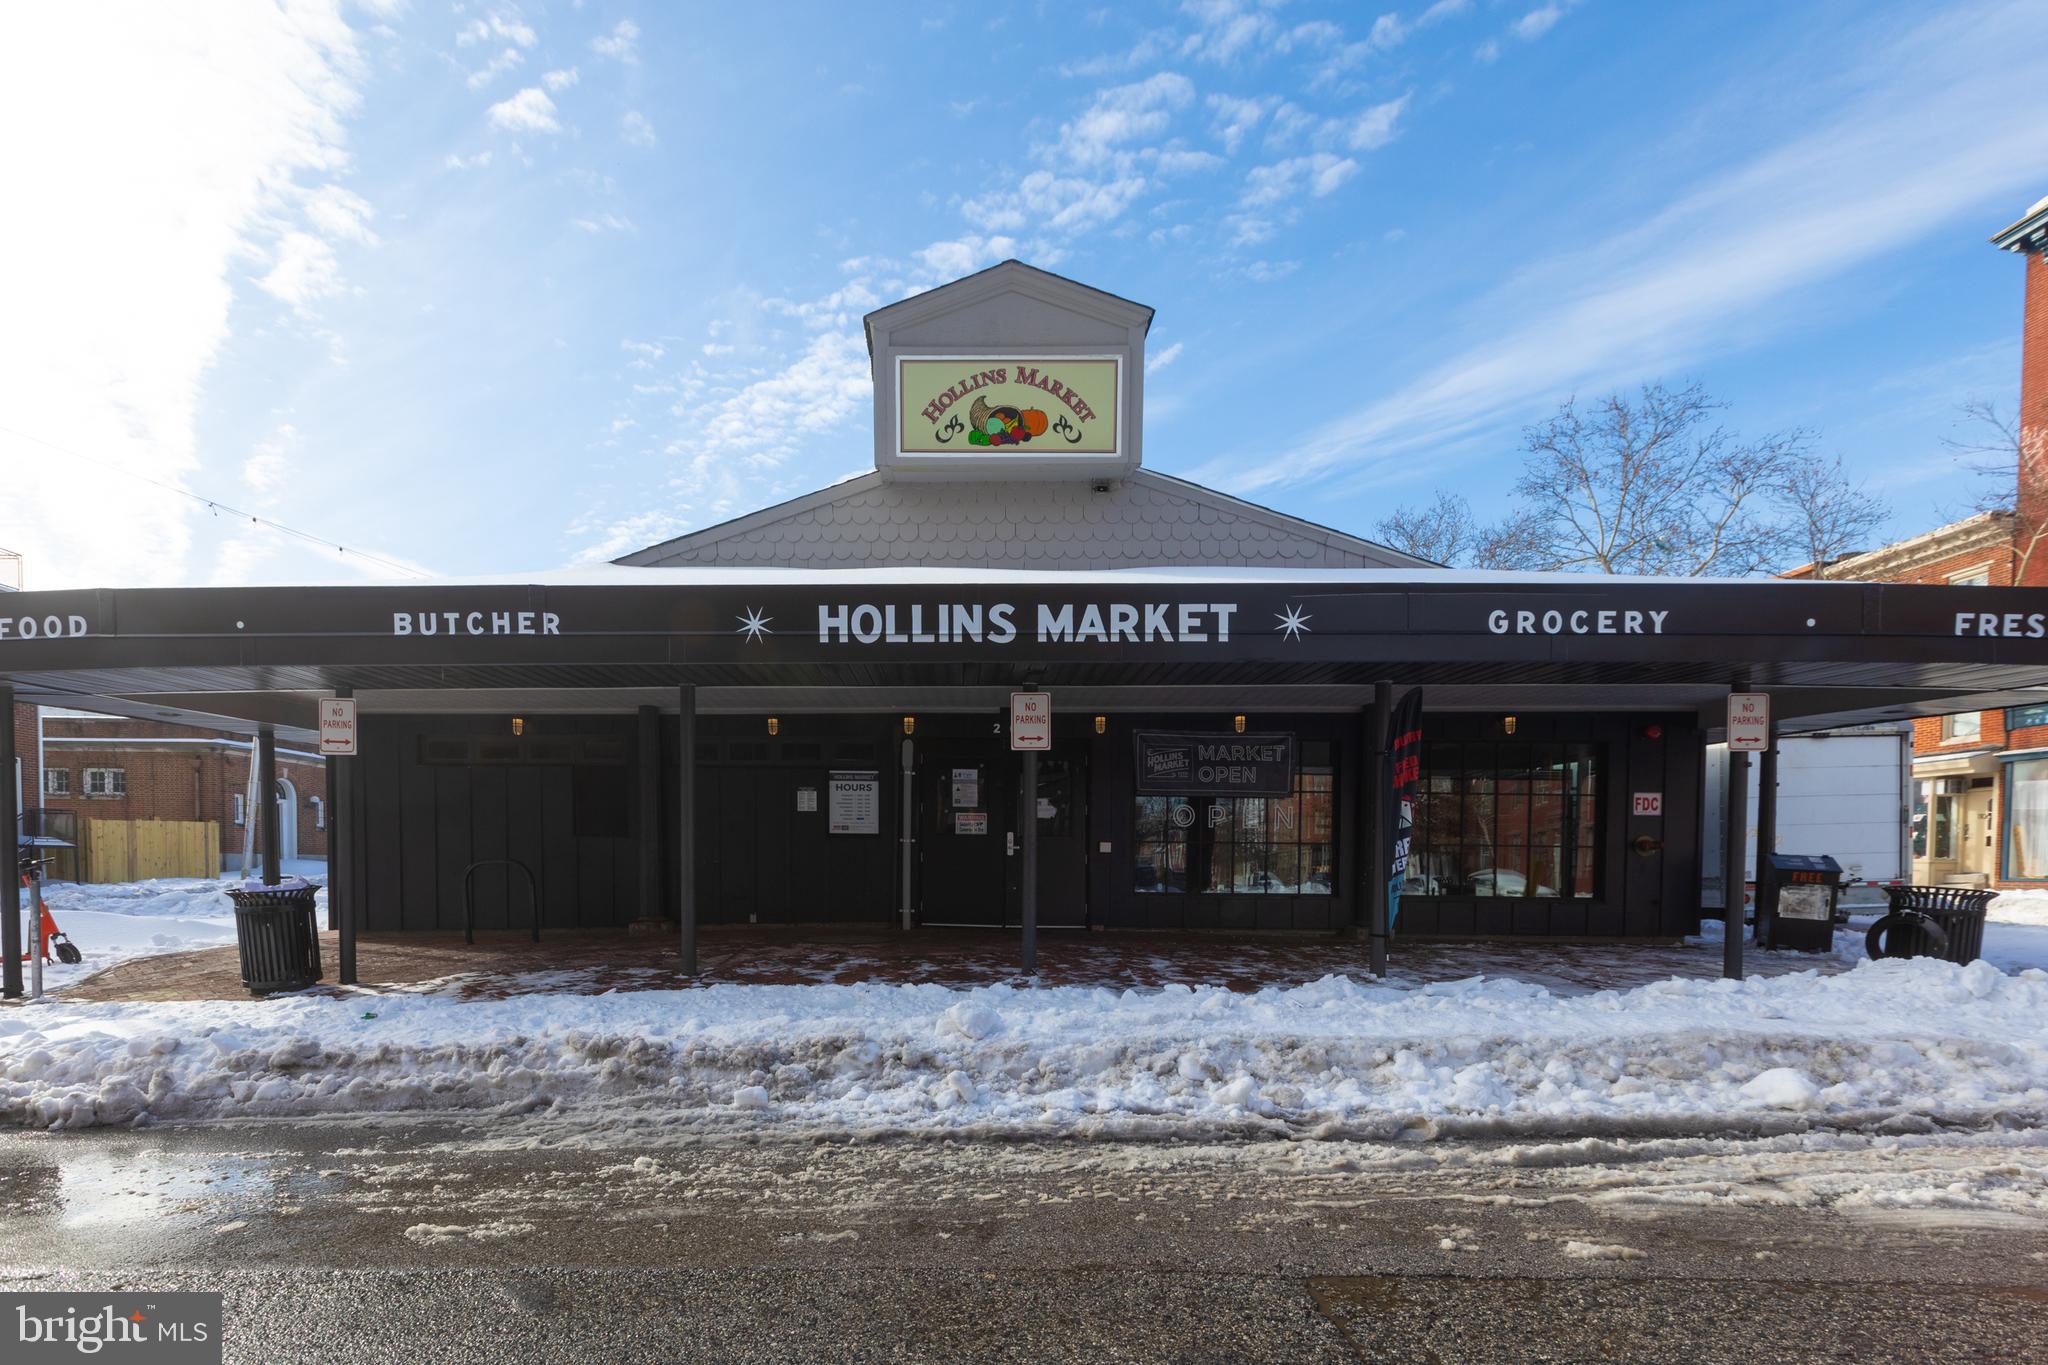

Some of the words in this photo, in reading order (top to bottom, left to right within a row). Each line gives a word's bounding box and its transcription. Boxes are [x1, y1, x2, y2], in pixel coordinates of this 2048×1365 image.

[921, 368, 1007, 424] HOLLINS
[1014, 366, 1096, 423] MARKET
[393, 611, 561, 636] BUTCHER
[818, 603, 1017, 644] HOLLINS
[1037, 603, 1238, 643] MARKET
[1488, 609, 1669, 634] GROCERY
[1955, 612, 2046, 638] FRES
[332, 707, 344, 717] NO
[1024, 702, 1037, 712] NO
[1742, 703, 1755, 713] NO
[323, 720, 352, 729] PARKING
[1015, 714, 1046, 725] PARKING
[1732, 716, 1764, 726] PARKING
[1147, 751, 1184, 768] HOLLINS
[1198, 744, 1285, 762] MARKET
[1153, 759, 1190, 773] MARKET
[1198, 766, 1257, 783] OPEN
[835, 783, 873, 792] HOURS
[1634, 796, 1659, 812] FDC
[1172, 805, 1294, 830] OPEN
